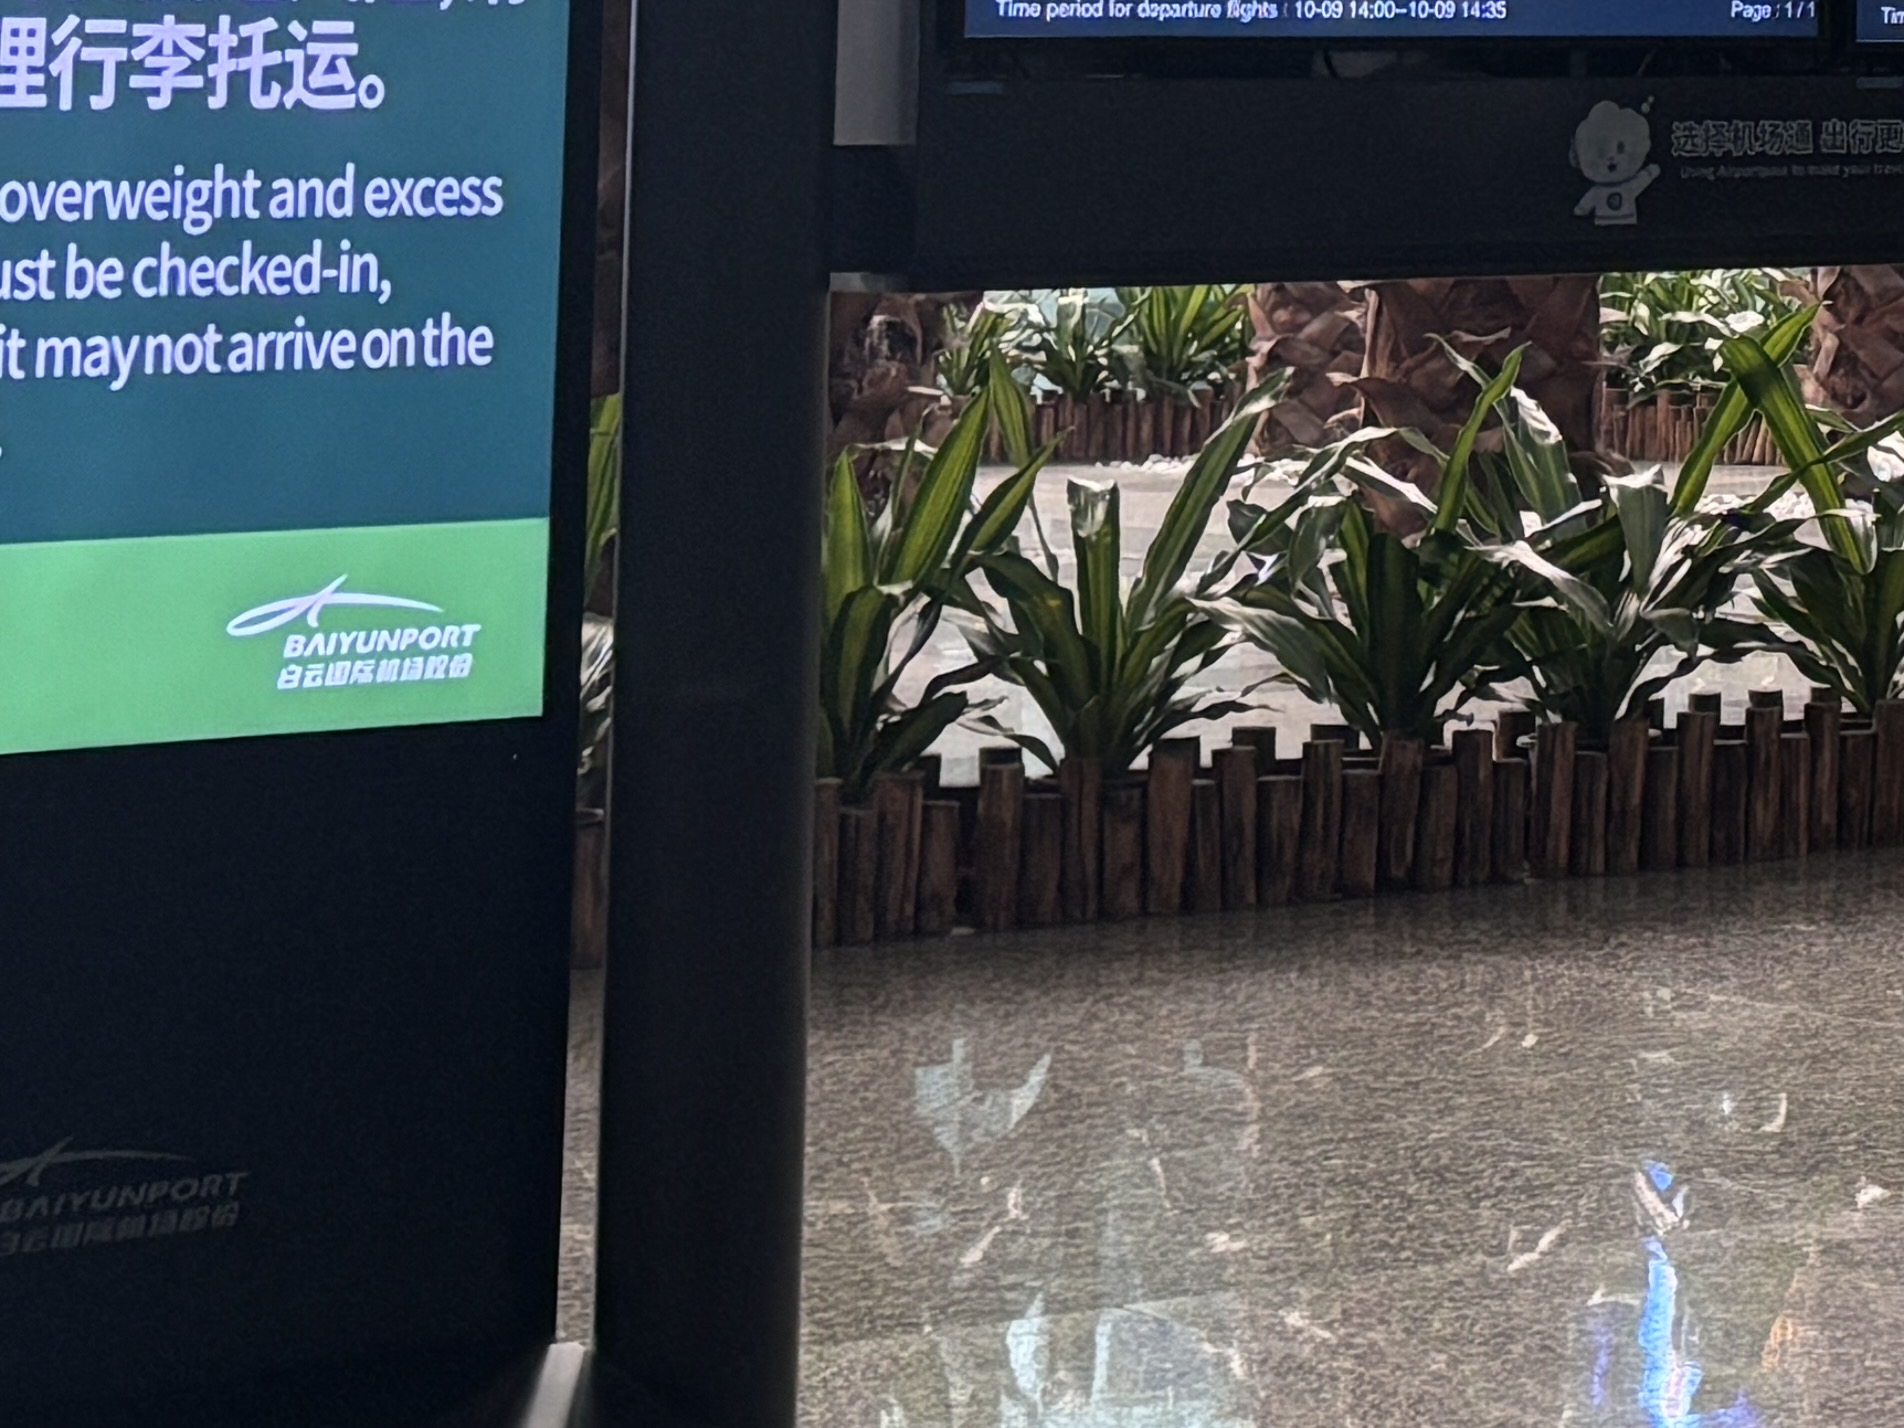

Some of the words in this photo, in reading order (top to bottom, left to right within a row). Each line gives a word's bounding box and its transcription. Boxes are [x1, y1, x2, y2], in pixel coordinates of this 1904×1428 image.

[1671, 119, 1814, 158] 选择机场通
[0, 163, 262, 236] overweight
[270, 163, 355, 218] and
[364, 175, 503, 217] excess
[65, 242, 125, 301] be
[132, 239, 391, 308] checked-in,
[35, 334, 141, 392] may
[144, 323, 224, 377] not
[226, 316, 356, 374] arrive
[360, 330, 415, 372] on
[418, 312, 494, 368] the
[282, 623, 482, 658] BAIYUNPORT
